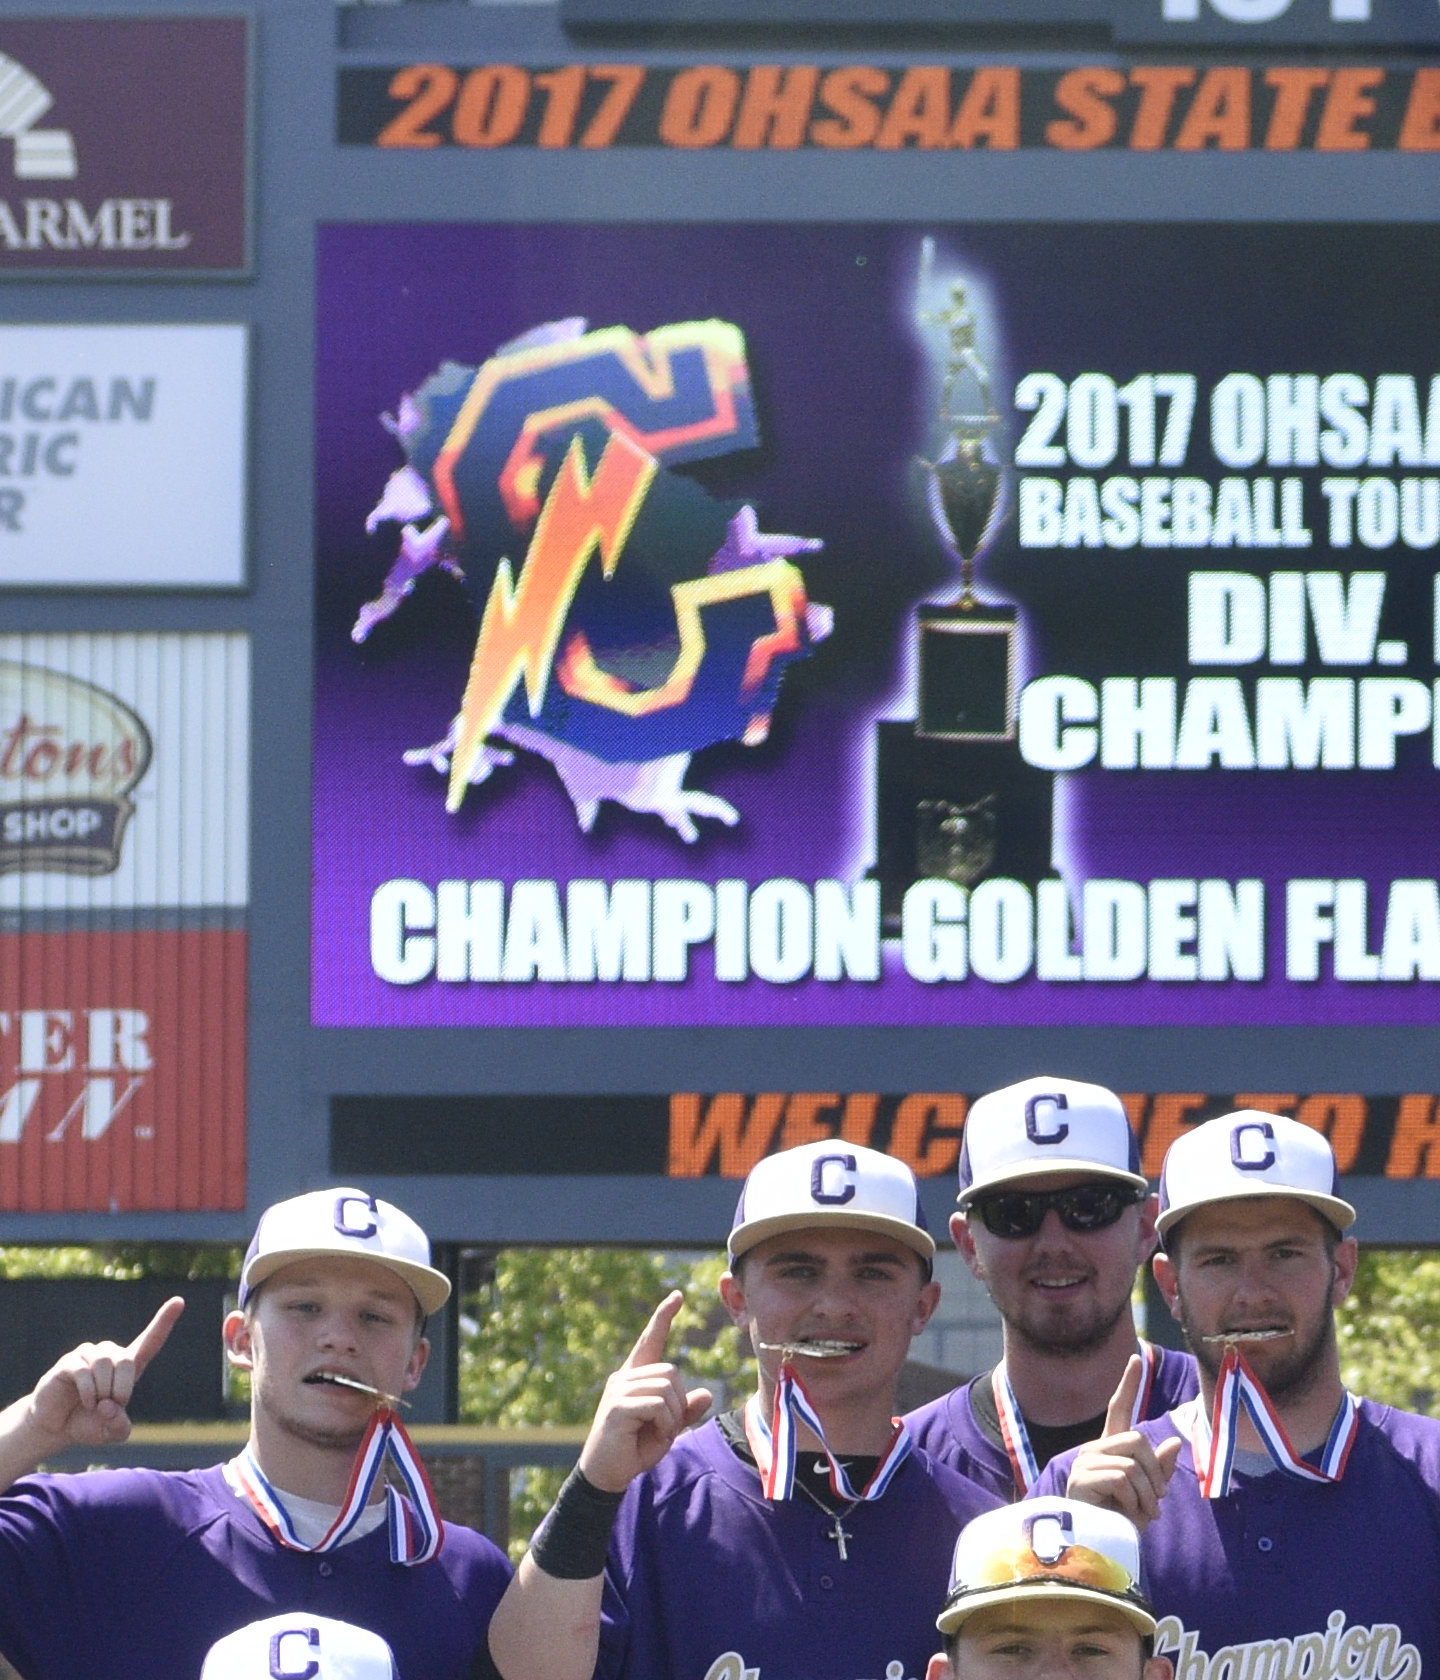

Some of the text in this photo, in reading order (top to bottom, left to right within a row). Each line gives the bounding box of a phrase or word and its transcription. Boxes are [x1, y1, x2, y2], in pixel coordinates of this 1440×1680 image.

[376, 64, 646, 150] 2017
[661, 65, 1021, 151] OHSAA
[1044, 66, 1385, 152] STATE
[1014, 373, 1197, 468] 2017
[1019, 477, 1312, 549] BASEBALL
[1188, 571, 1408, 665] DIV.
[4, 809, 100, 844] SHOP
[369, 878, 881, 984] CHAMPION
[902, 878, 1264, 984] GOLDEN
[666, 1092, 1206, 1179] WELCE
[1024, 1093, 1070, 1144] C
[1230, 1122, 1275, 1170] C
[810, 1154, 856, 1204] C
[334, 1197, 379, 1237] C
